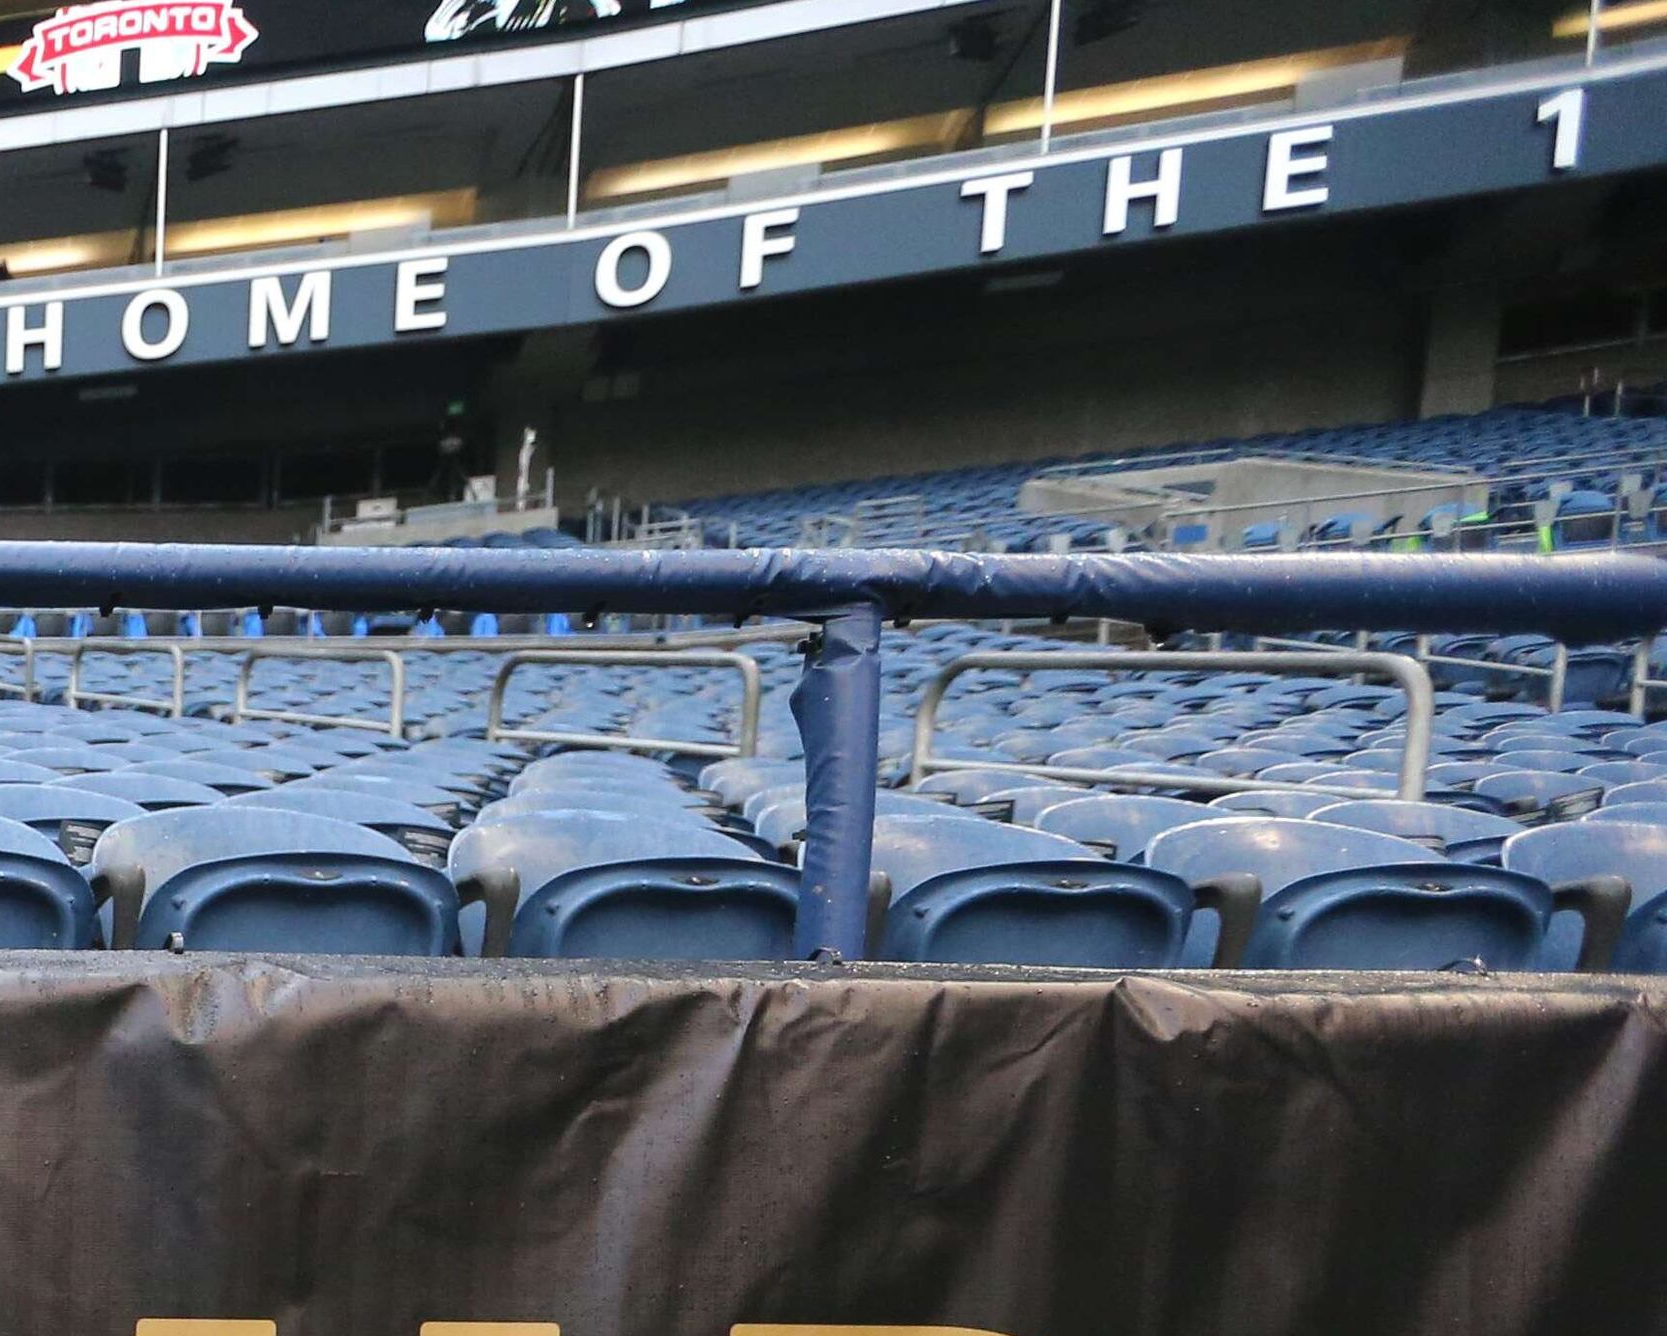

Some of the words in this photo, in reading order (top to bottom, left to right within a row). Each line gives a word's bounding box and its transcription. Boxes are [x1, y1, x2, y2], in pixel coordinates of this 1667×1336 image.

[47, 6, 217, 51] TORONTO
[4, 257, 449, 376] HOME
[594, 207, 800, 309] OF
[960, 124, 1334, 254] THE
[1537, 87, 1585, 169] 1
